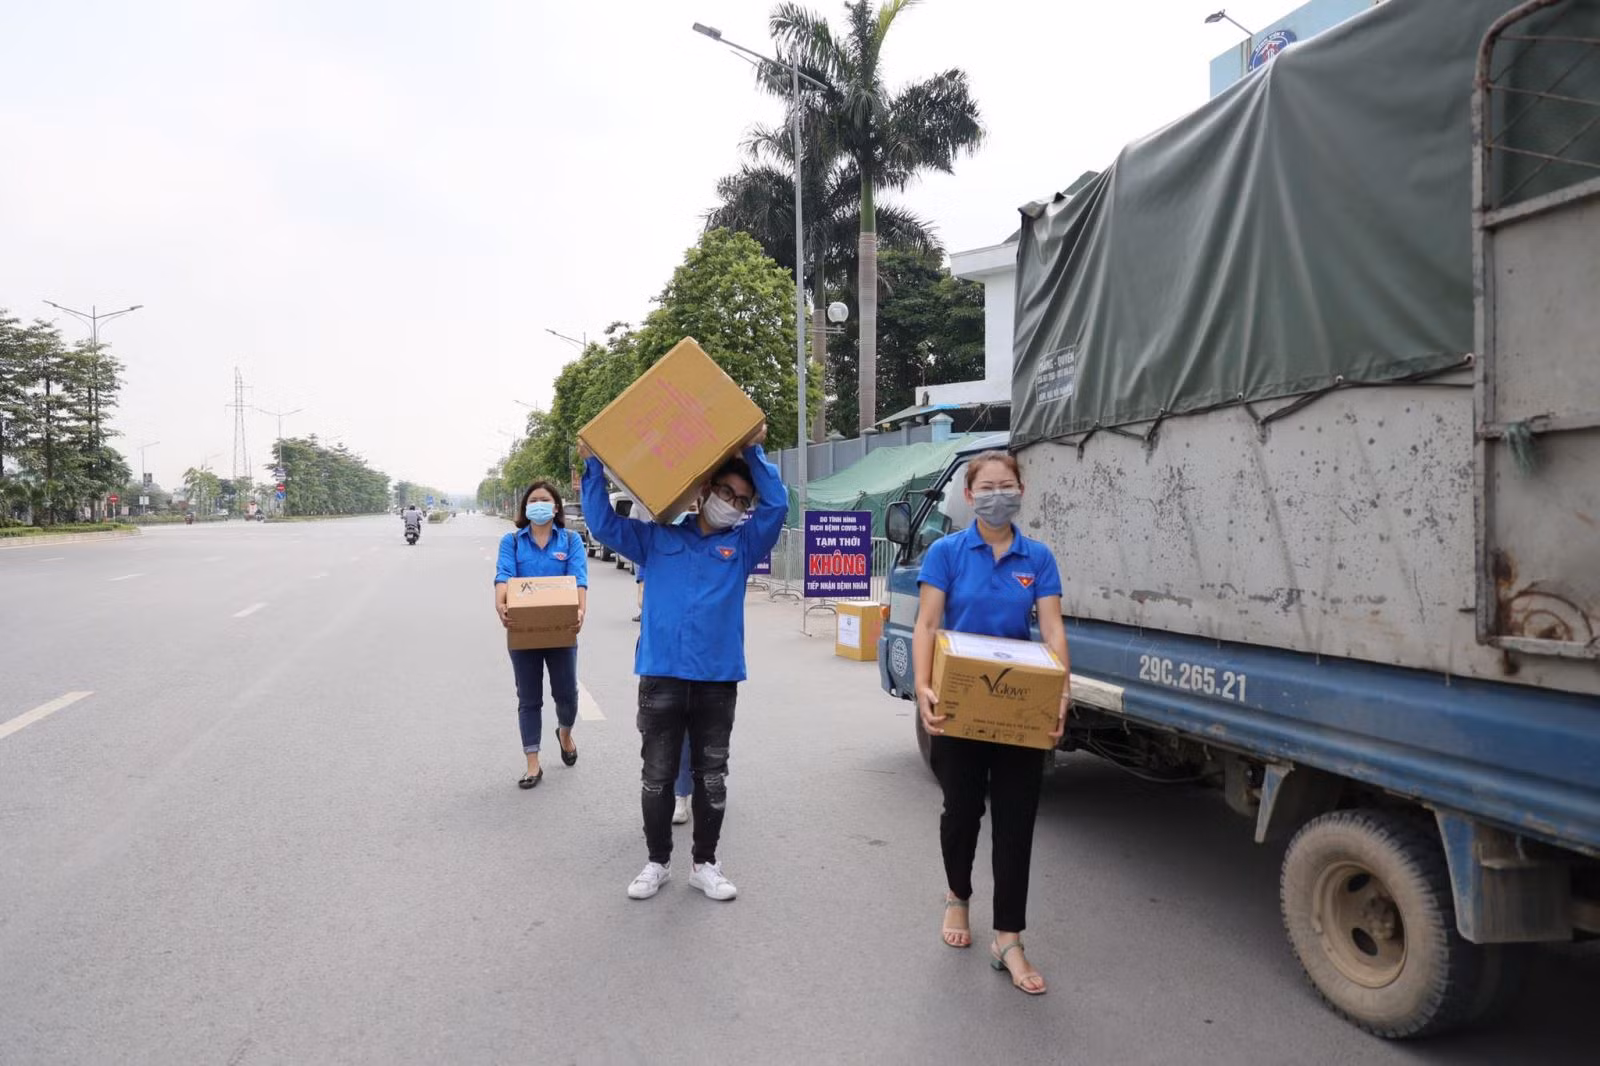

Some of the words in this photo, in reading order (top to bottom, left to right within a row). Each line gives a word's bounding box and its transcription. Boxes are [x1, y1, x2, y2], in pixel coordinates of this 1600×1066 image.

[840, 524, 866, 532] COVID-19
[816, 537, 837, 548] TẠM
[839, 535, 861, 547] THỜI
[809, 549, 867, 576] KHÔNG
[1139, 654, 1247, 703] 29C.265.21
